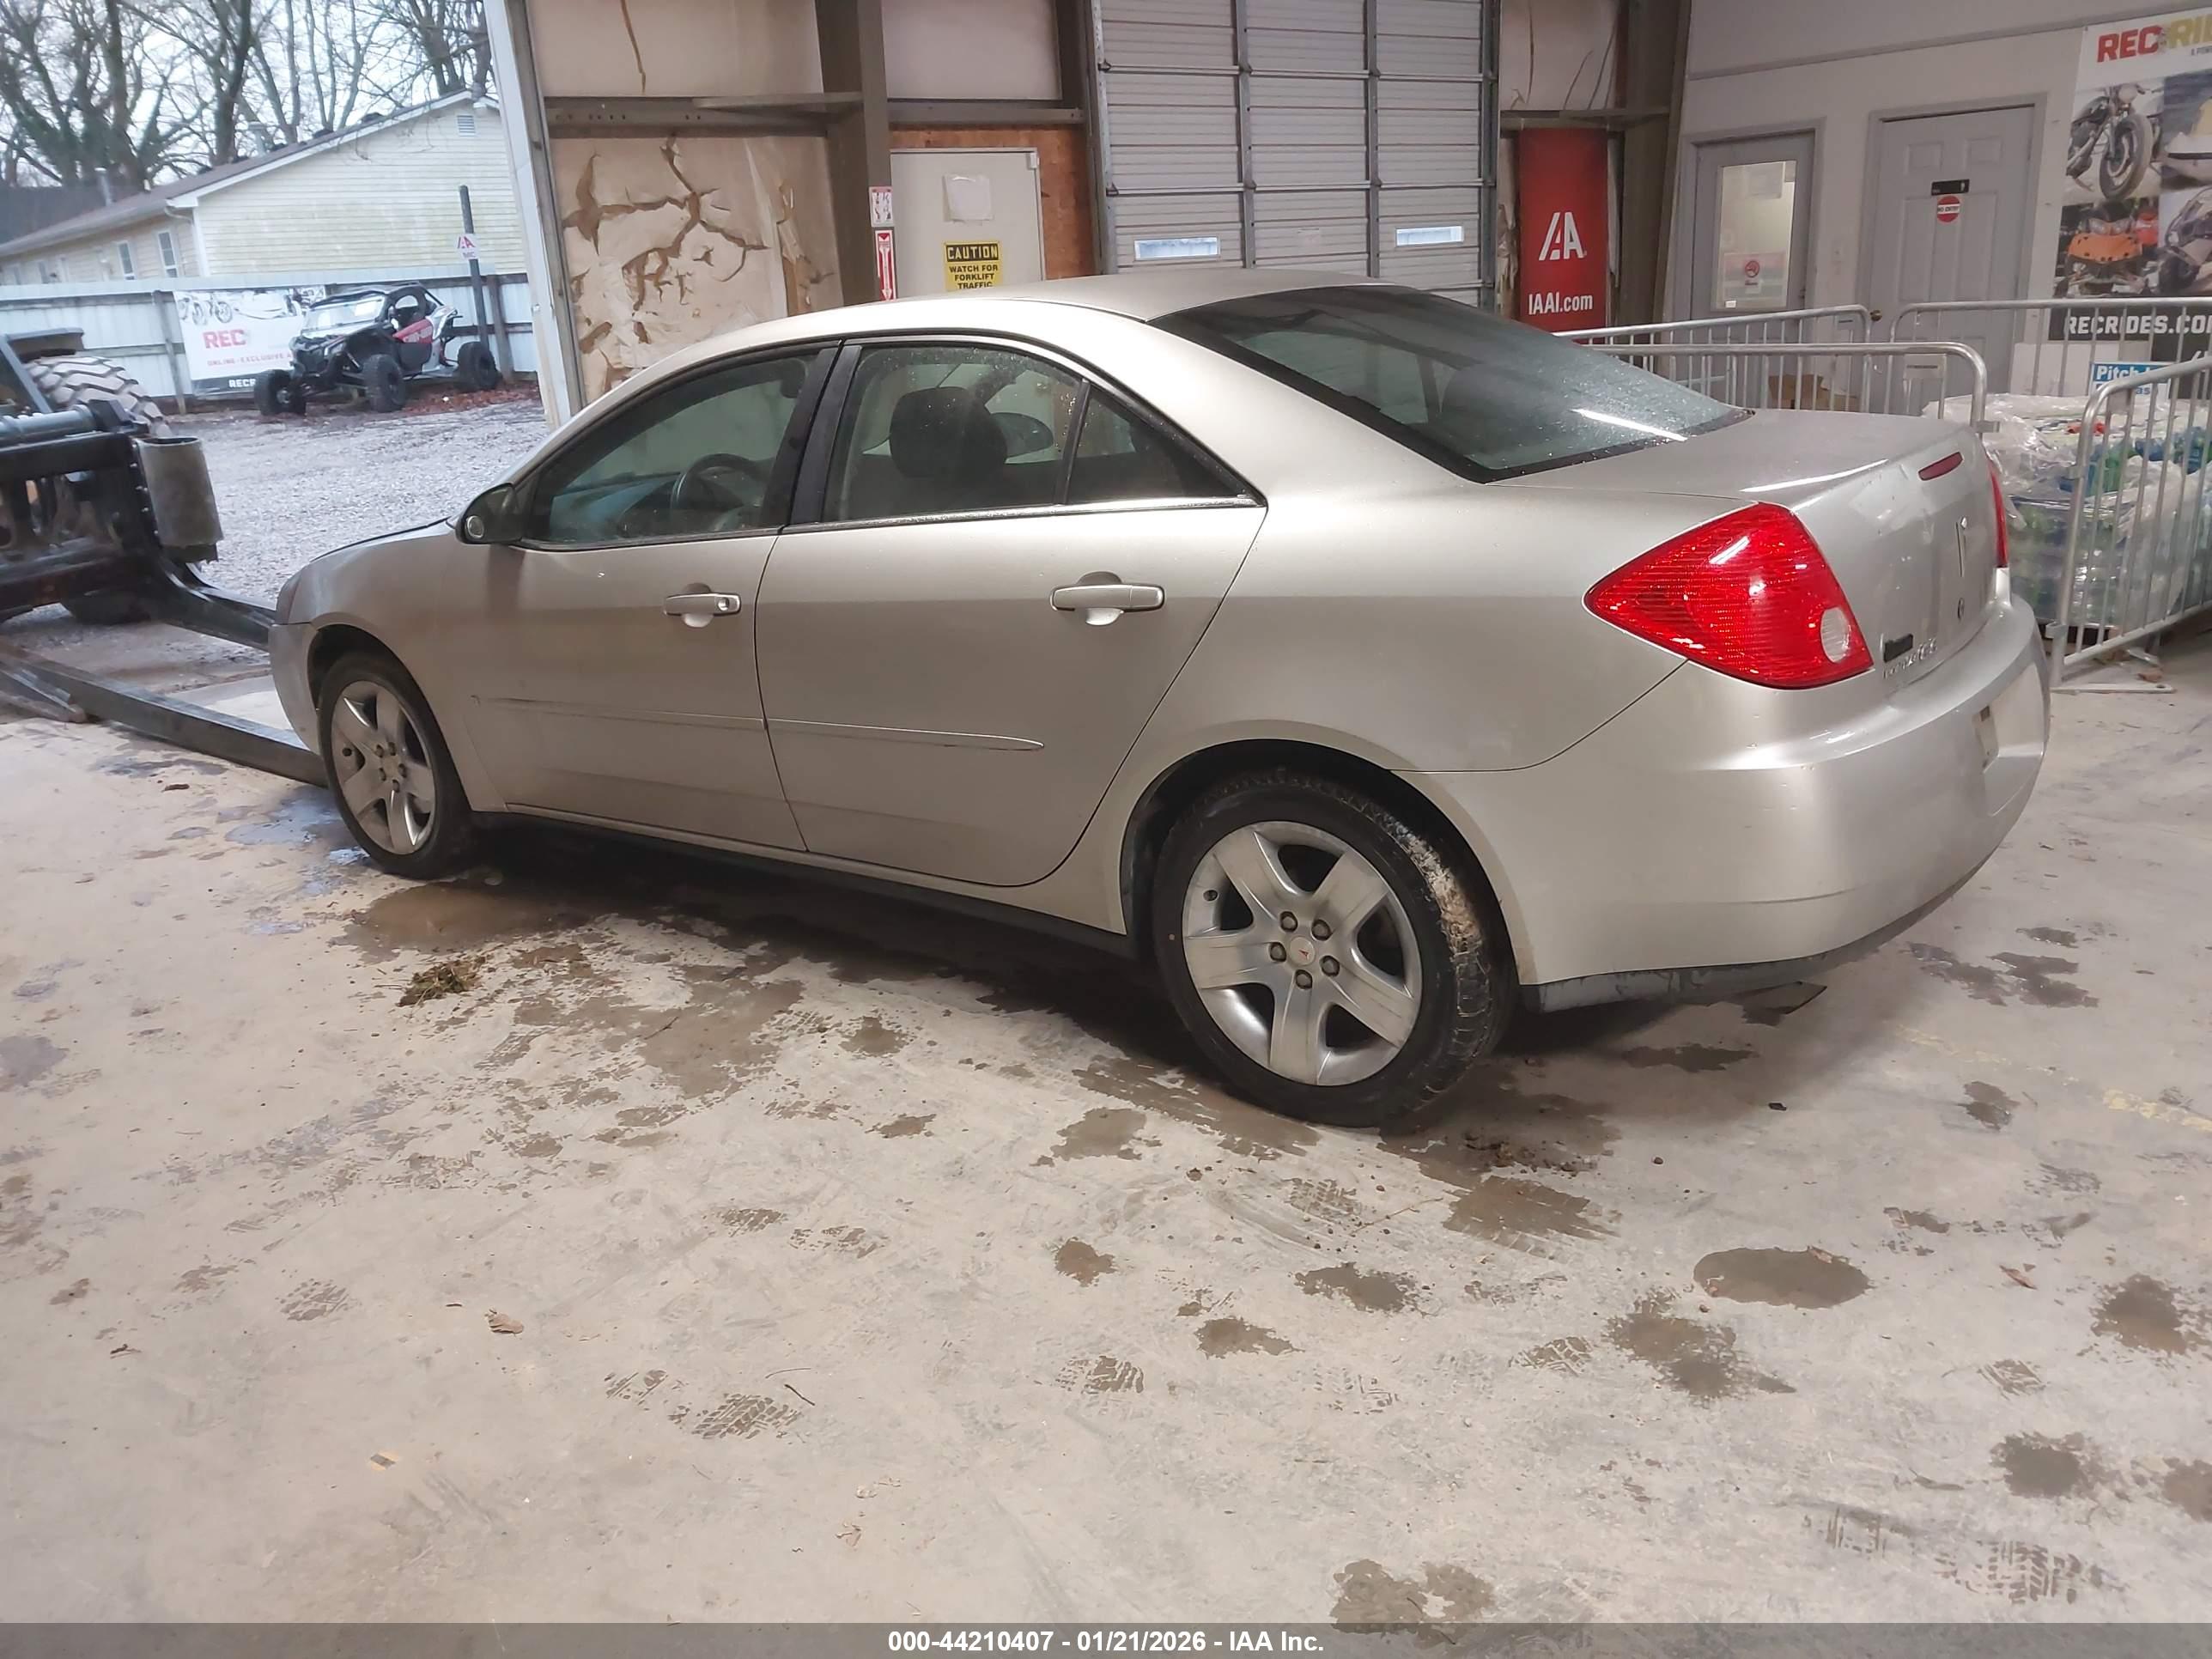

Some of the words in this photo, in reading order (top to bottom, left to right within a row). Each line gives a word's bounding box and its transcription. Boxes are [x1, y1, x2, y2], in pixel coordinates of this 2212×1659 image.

[2097, 25, 2163, 63] REC
[947, 246, 998, 259] CAUTION
[949, 264, 979, 273] WATCH
[954, 273, 995, 282] FORKLIFT
[957, 281, 994, 289] TRAFFIC
[1528, 292, 1593, 315] IAAI.com
[203, 329, 246, 349] REC
